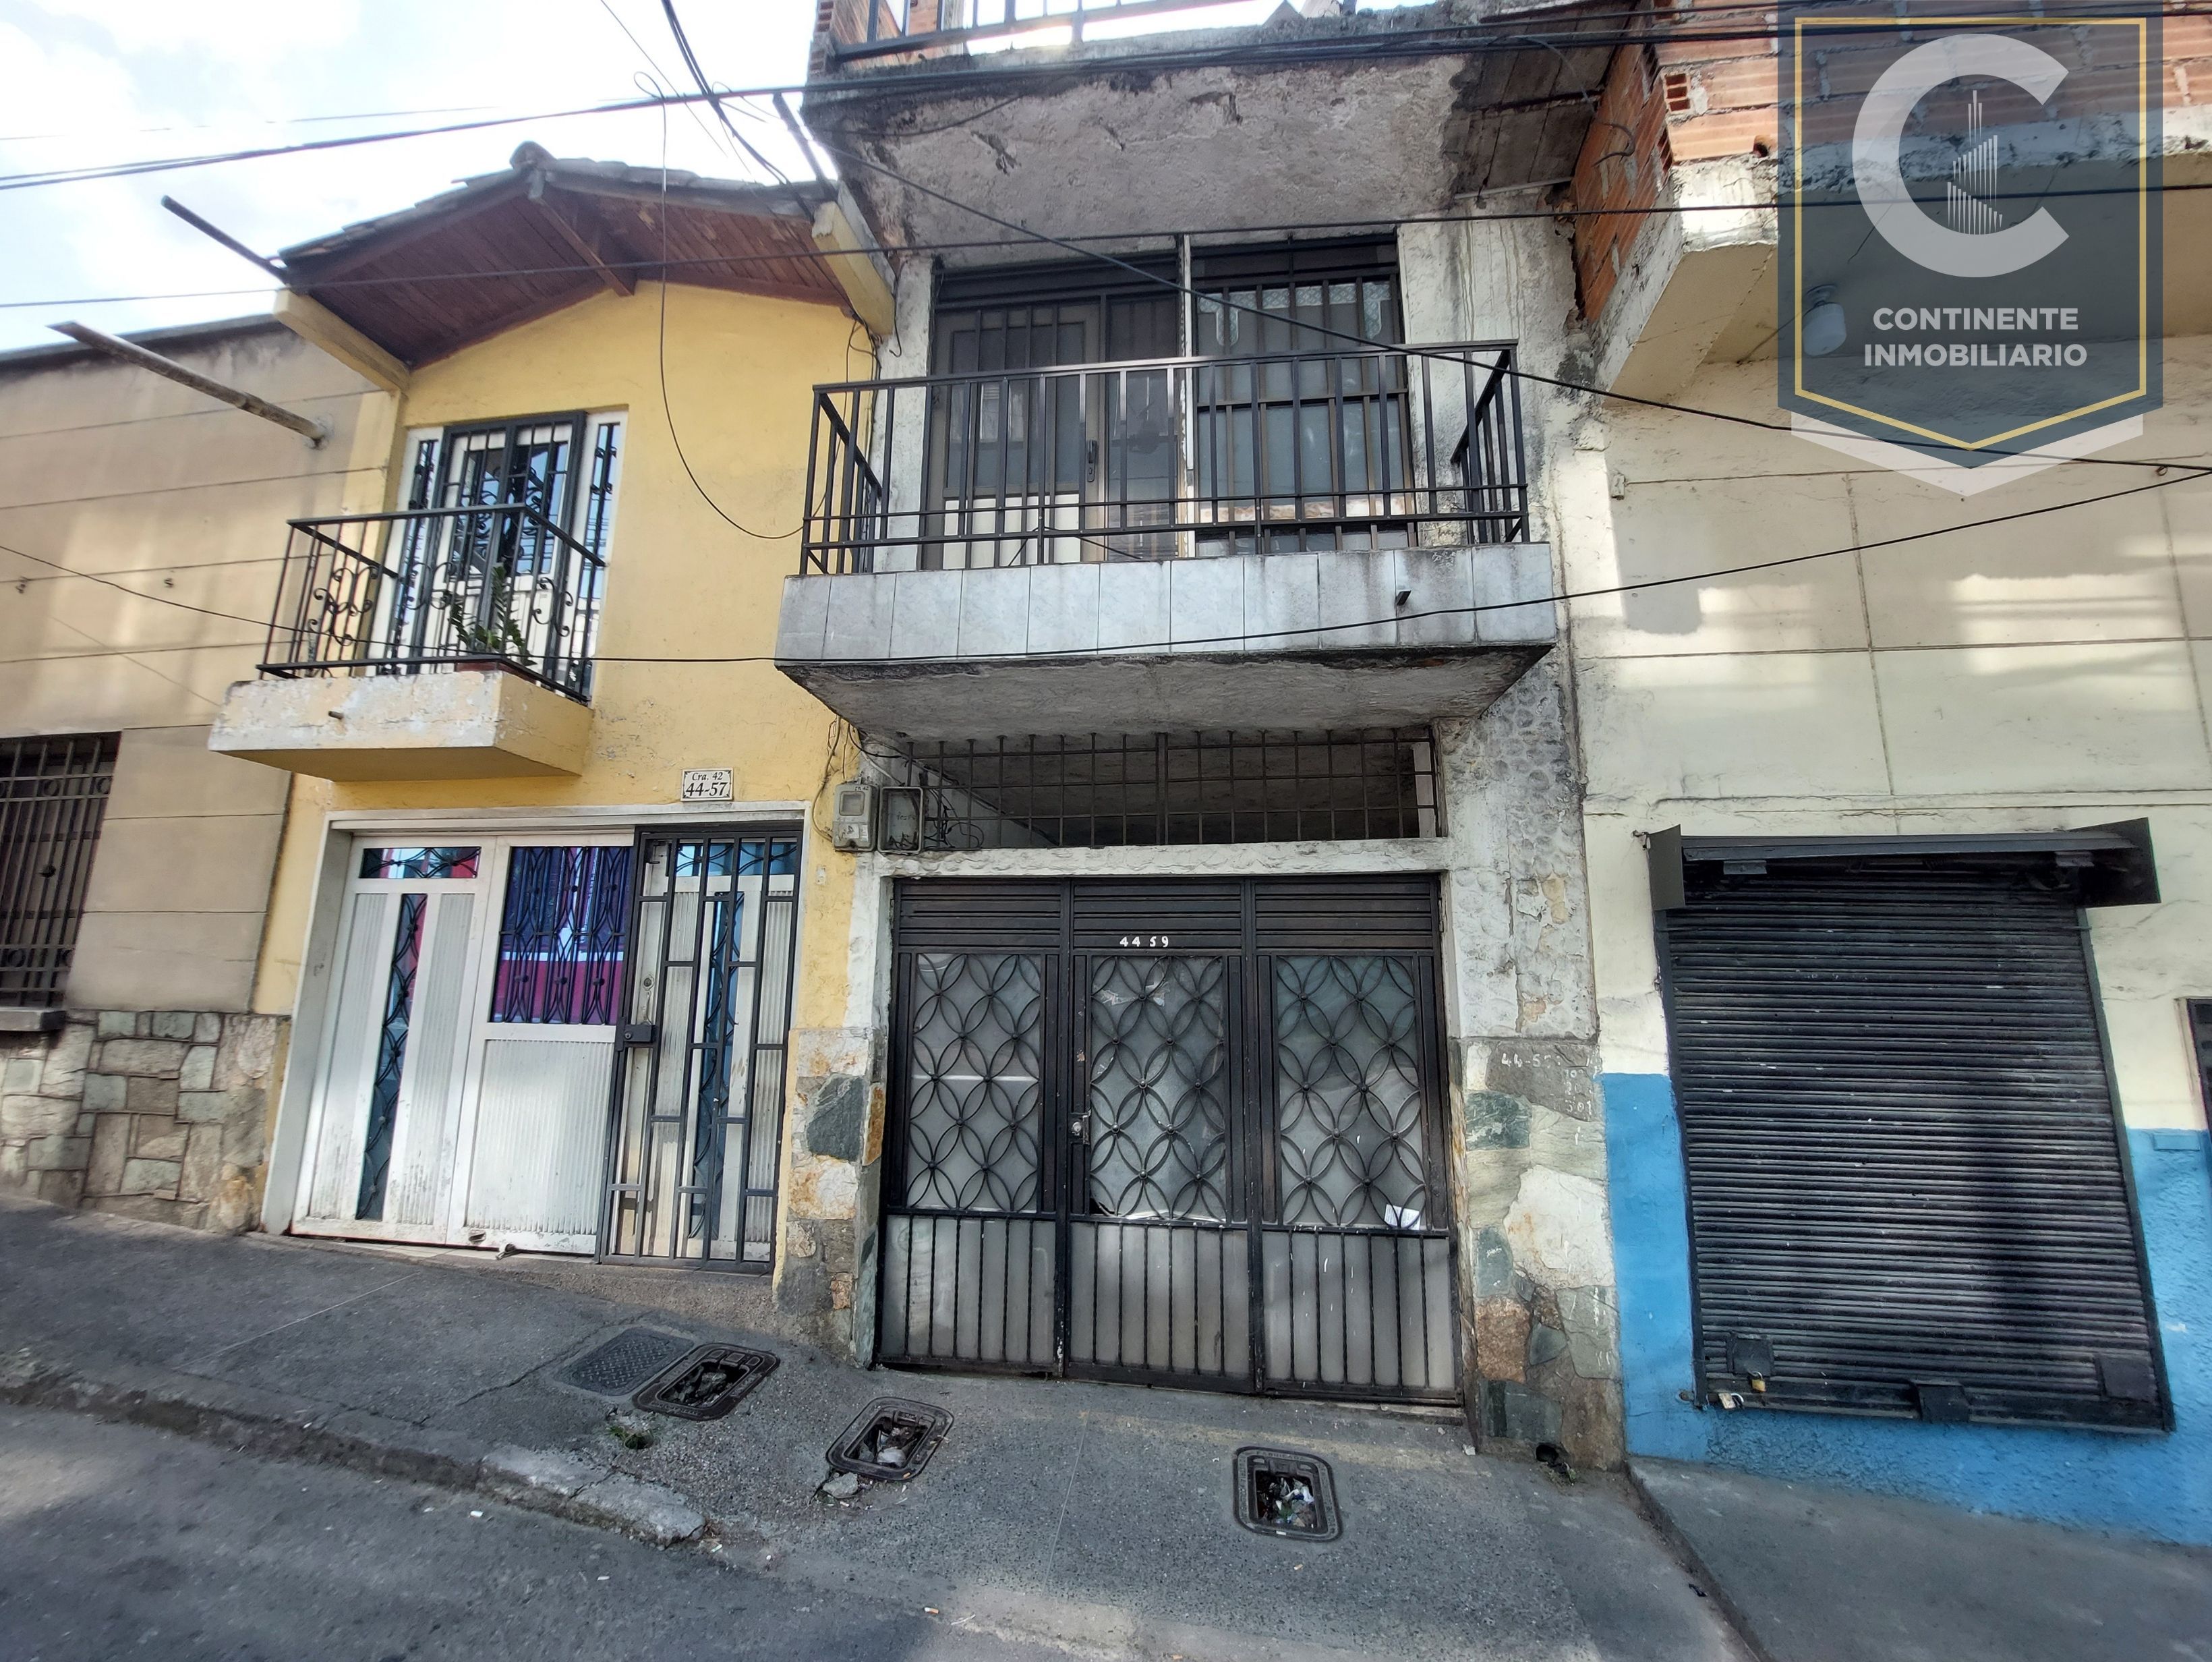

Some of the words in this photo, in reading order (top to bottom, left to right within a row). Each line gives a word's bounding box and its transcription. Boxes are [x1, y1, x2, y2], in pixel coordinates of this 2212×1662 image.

[692, 772, 709, 781] Cra.
[712, 772, 723, 780] 42
[685, 782, 728, 797] 44-57
